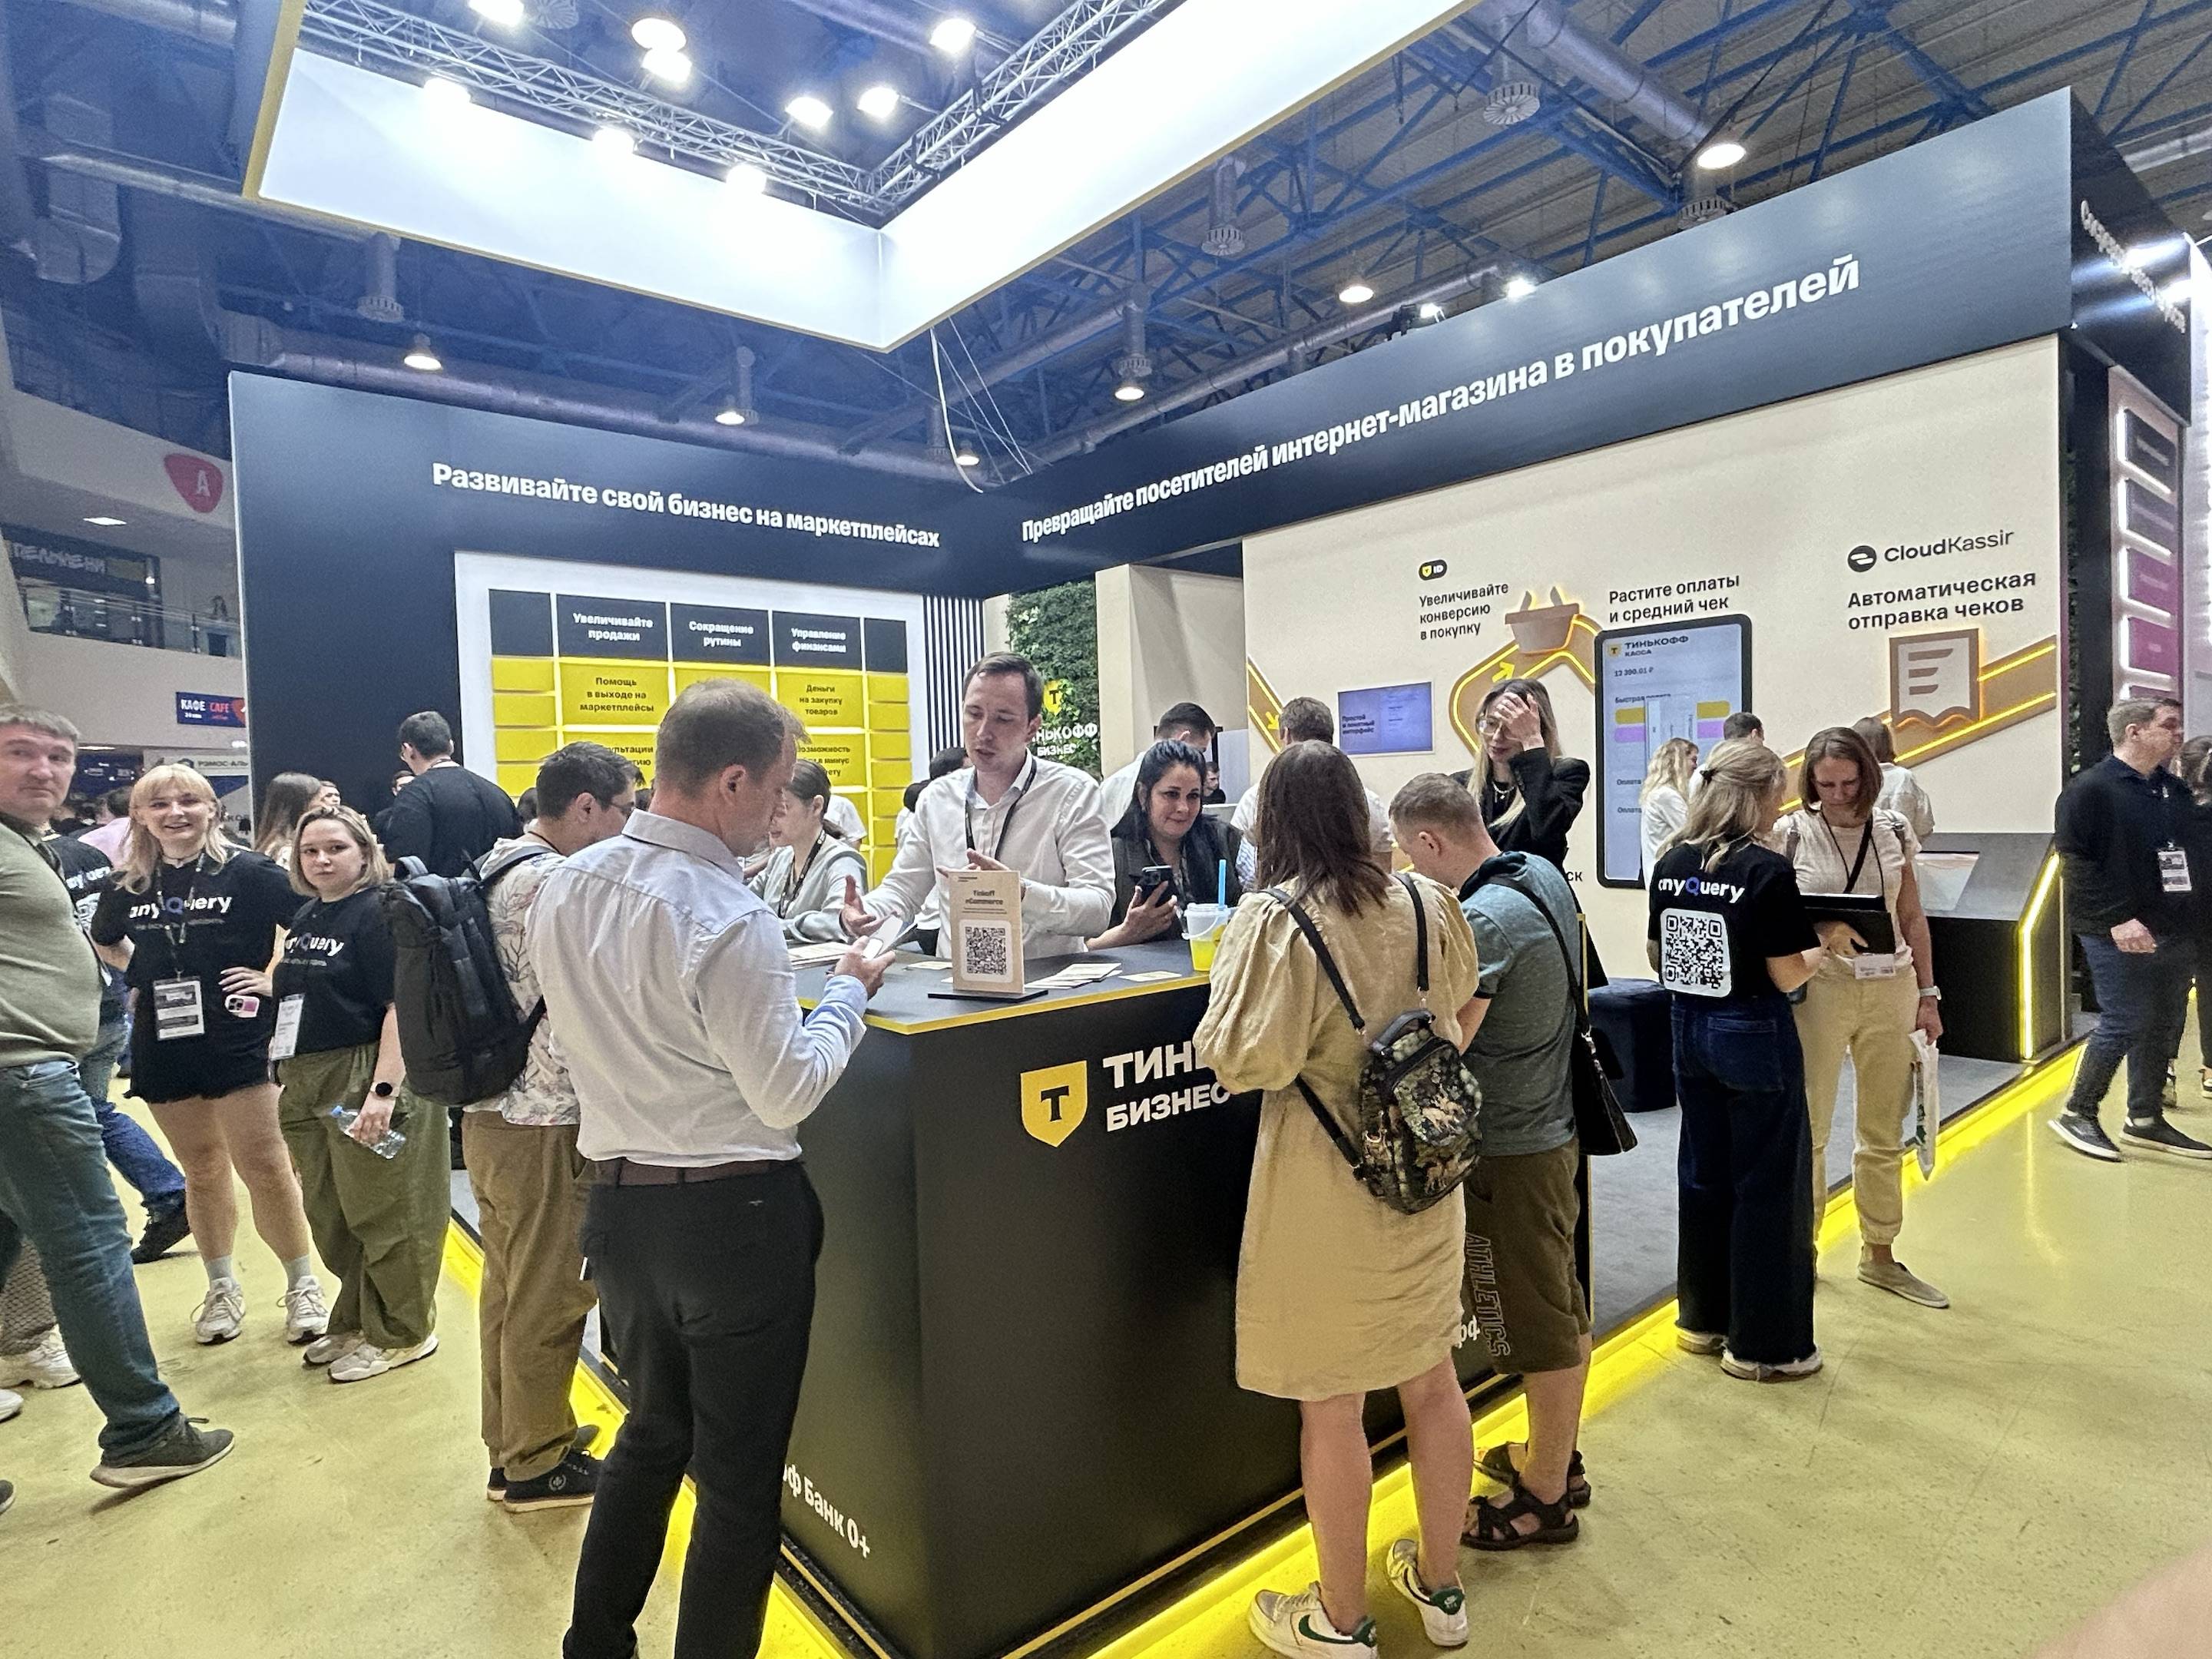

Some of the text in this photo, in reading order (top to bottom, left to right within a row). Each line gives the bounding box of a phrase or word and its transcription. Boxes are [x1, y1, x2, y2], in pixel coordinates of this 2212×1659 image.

[1022, 253, 1859, 543] Превращайте посетителей интернет-магазина в покупателей
[432, 462, 940, 548] Развивайте свой бизнес на маркетплейсах
[1884, 529, 2015, 561] CloudKassir
[1433, 565, 1444, 574] ID
[1419, 584, 1509, 608] Увеличивайте
[1609, 575, 1740, 604] Растите оплаты
[1848, 572, 2036, 608] Автоматическая
[1420, 604, 1491, 624] конверсию
[1610, 597, 1729, 623] и средний чек
[1848, 598, 2024, 630] отправка чеков
[573, 613, 653, 628] Увеличивайте
[689, 621, 753, 635] Сокращение
[588, 630, 641, 642] продажи
[791, 628, 846, 641] Управление
[1420, 623, 1481, 641] в покупку
[704, 636, 741, 647] рутины
[792, 641, 846, 654] финансами
[1624, 635, 1689, 650] ТИНЬКОФФ
[595, 677, 637, 687] Помощь
[806, 684, 836, 693] Деньги
[595, 691, 633, 700] выходе
[180, 699, 206, 711] КАФЕ
[210, 702, 230, 713] CAFE
[580, 704, 654, 713] маркетплейсы
[1035, 723, 1098, 744] НЬКОФФ
[1037, 743, 1077, 757] БИЗНЕС
[1106, 1081, 1230, 1132] БИЗНЕС
[1465, 1231, 1512, 1356] ATHLETICS
[804, 1475, 846, 1538] Банк
[847, 1518, 871, 1559] 0+
